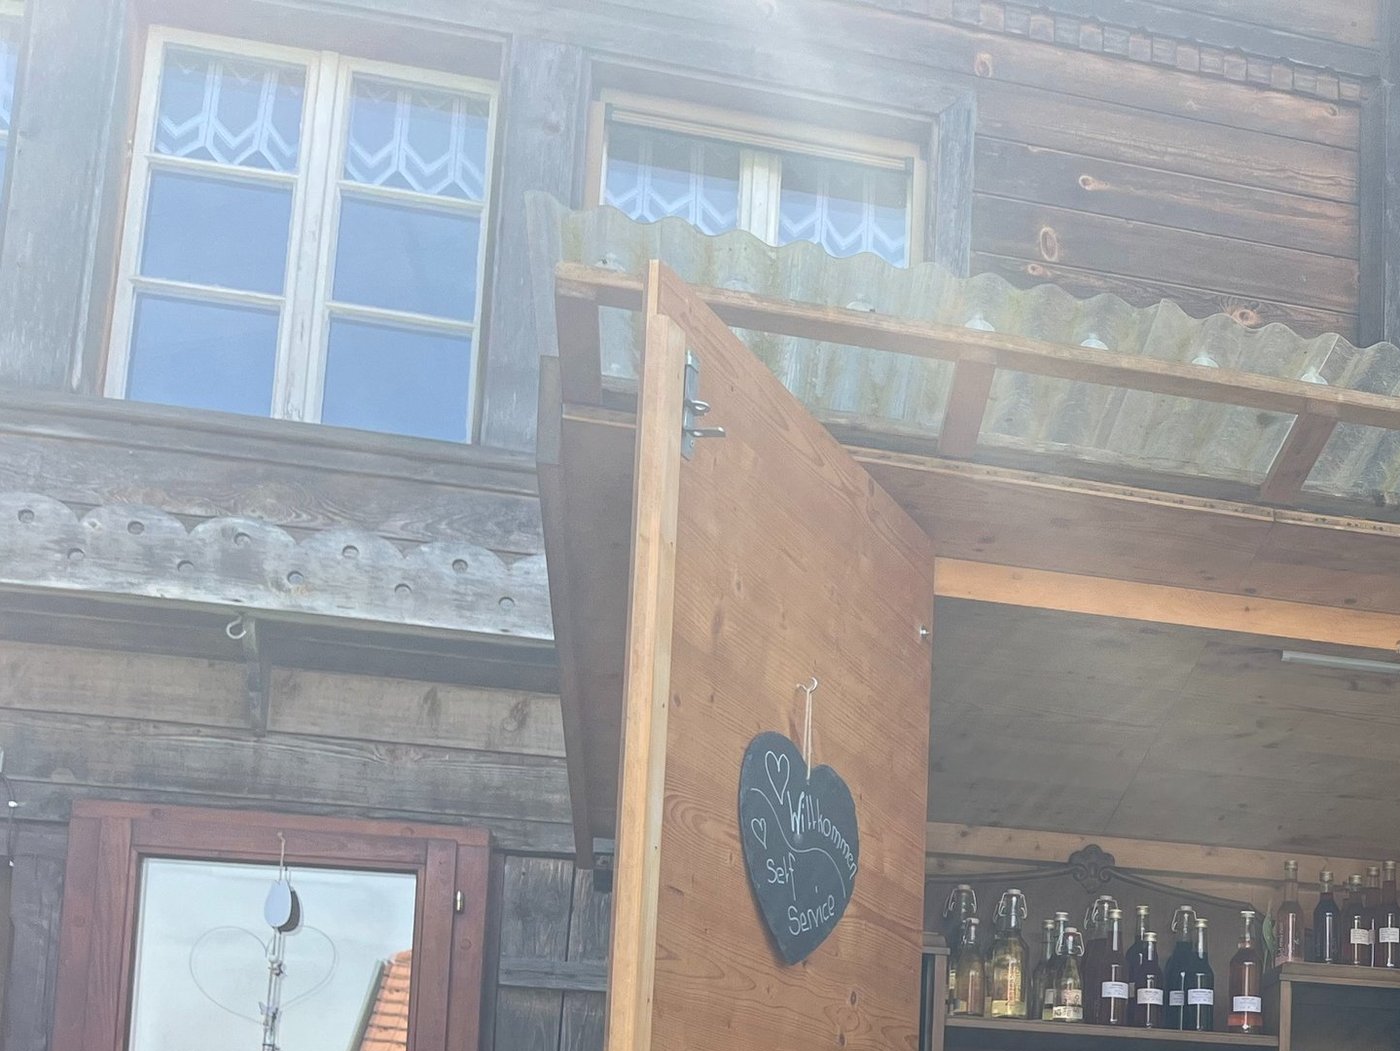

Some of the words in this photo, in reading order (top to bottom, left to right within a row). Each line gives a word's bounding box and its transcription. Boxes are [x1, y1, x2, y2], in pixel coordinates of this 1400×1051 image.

[787, 790, 857, 880] Willkommen
[766, 851, 796, 901] Self
[788, 884, 836, 936] Service
